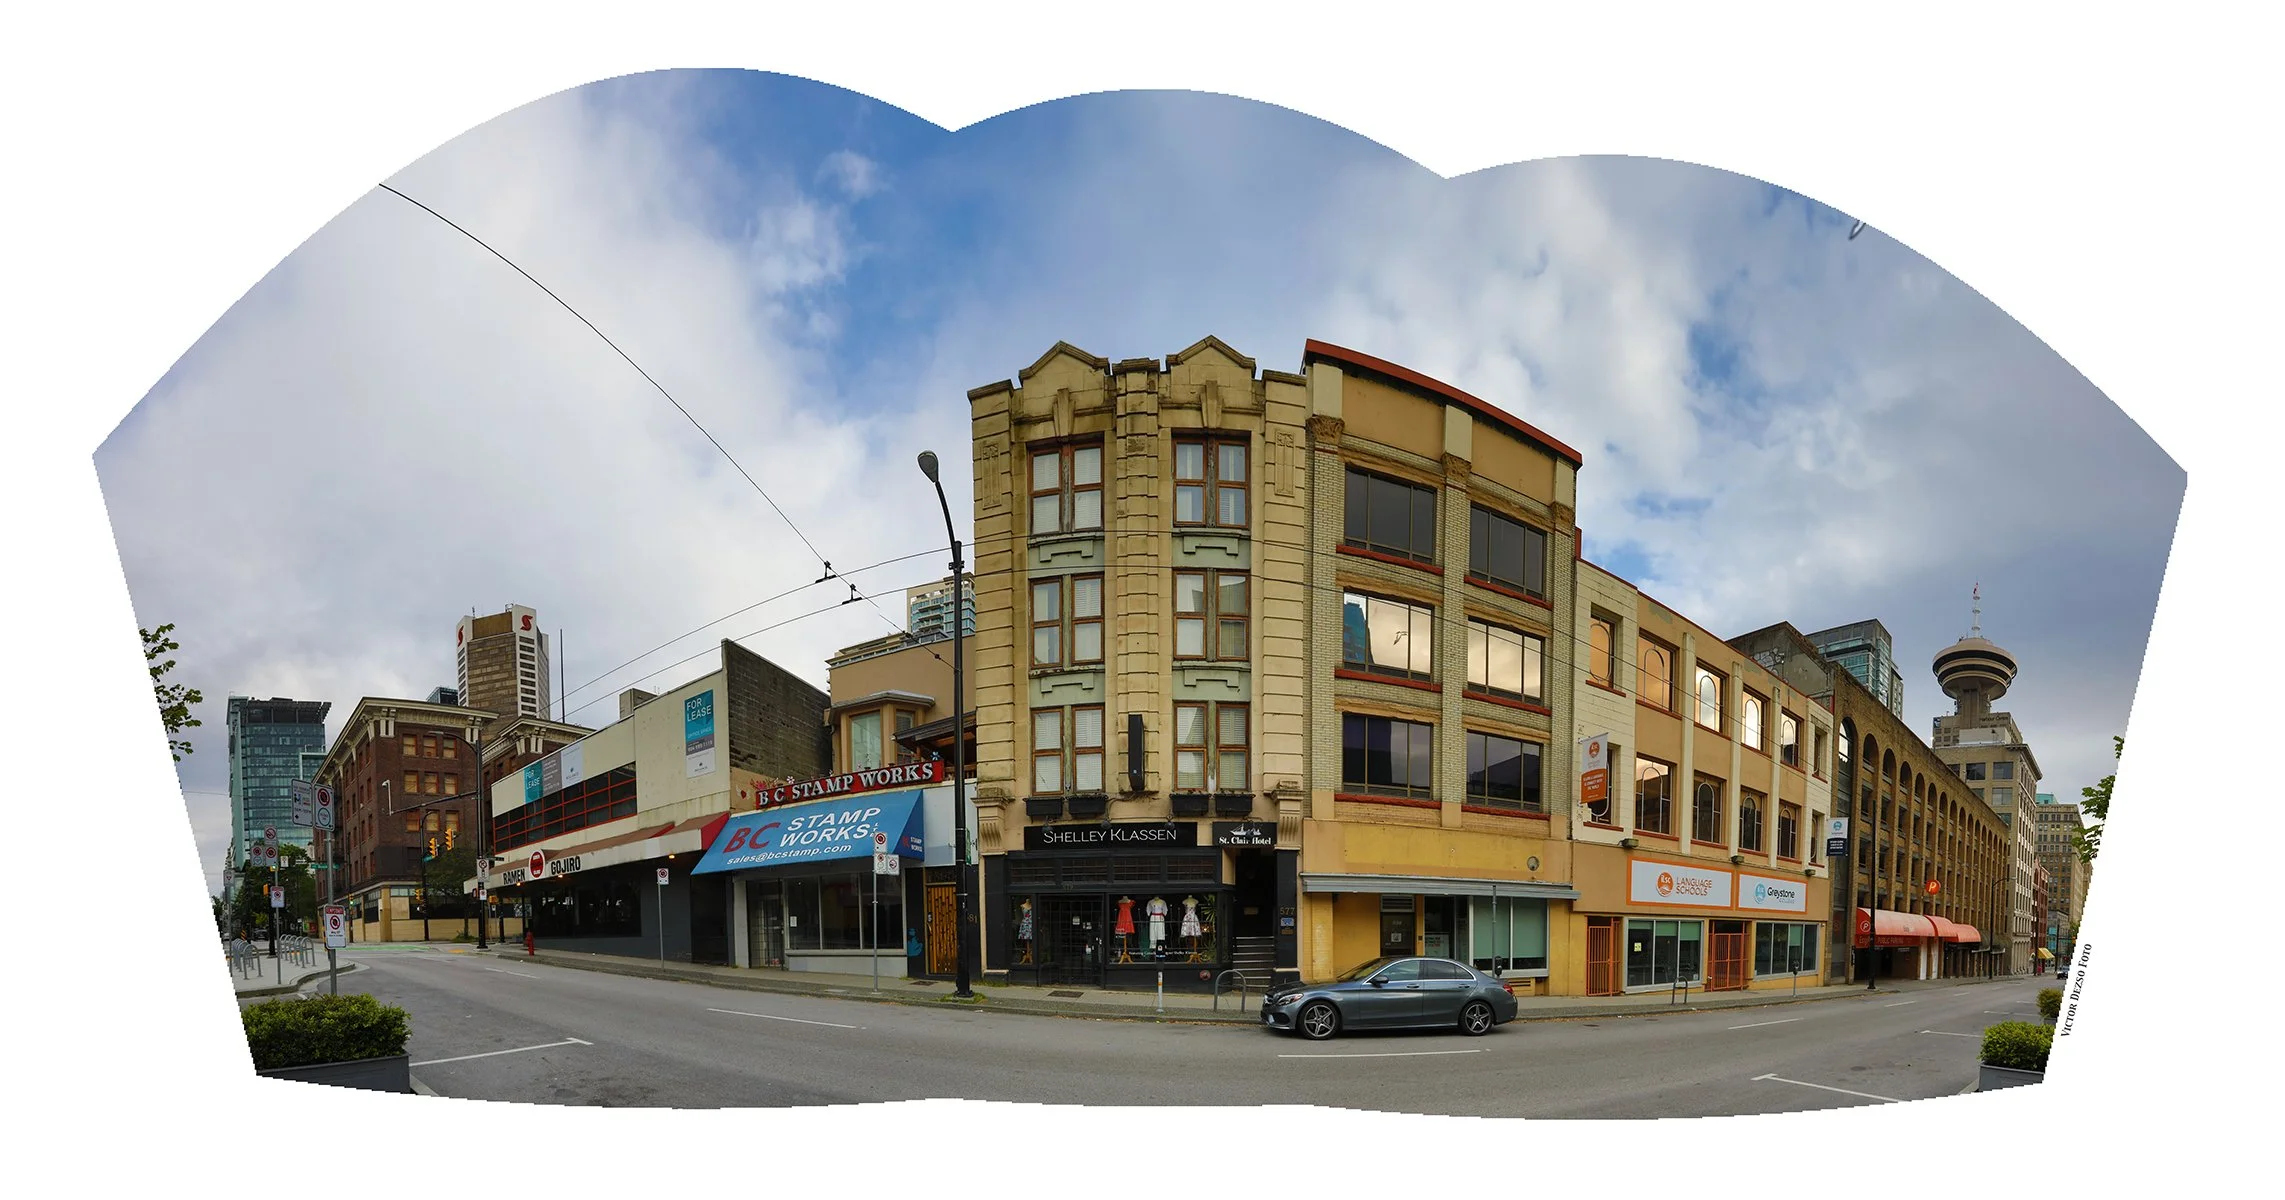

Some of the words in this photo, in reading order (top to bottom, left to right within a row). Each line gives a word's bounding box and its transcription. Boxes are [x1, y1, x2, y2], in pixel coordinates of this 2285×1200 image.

[686, 698, 702, 711] FOR
[687, 705, 712, 722] LEASE
[526, 777, 540, 789] LEASE
[759, 791, 768, 806] B
[774, 788, 785, 802] C
[792, 775, 853, 800] STAMP
[858, 763, 933, 787] WORKS
[787, 807, 881, 831] STAMP
[723, 822, 781, 853] BC
[780, 823, 871, 847] WORKS
[1043, 830, 1107, 843] SHELLEY
[1110, 828, 1177, 841] KLASSEN
[1219, 836, 1230, 844] St.
[727, 844, 852, 865] sales@bcstamp.com
[503, 868, 526, 885] RAMEN
[550, 855, 581, 875] GOJIRO
[1675, 885, 1708, 896] SCHOOLS
[1676, 877, 1712, 889] LANGUAGE
[1767, 886, 1795, 899] Greystone
[1280, 907, 1295, 915] 577
